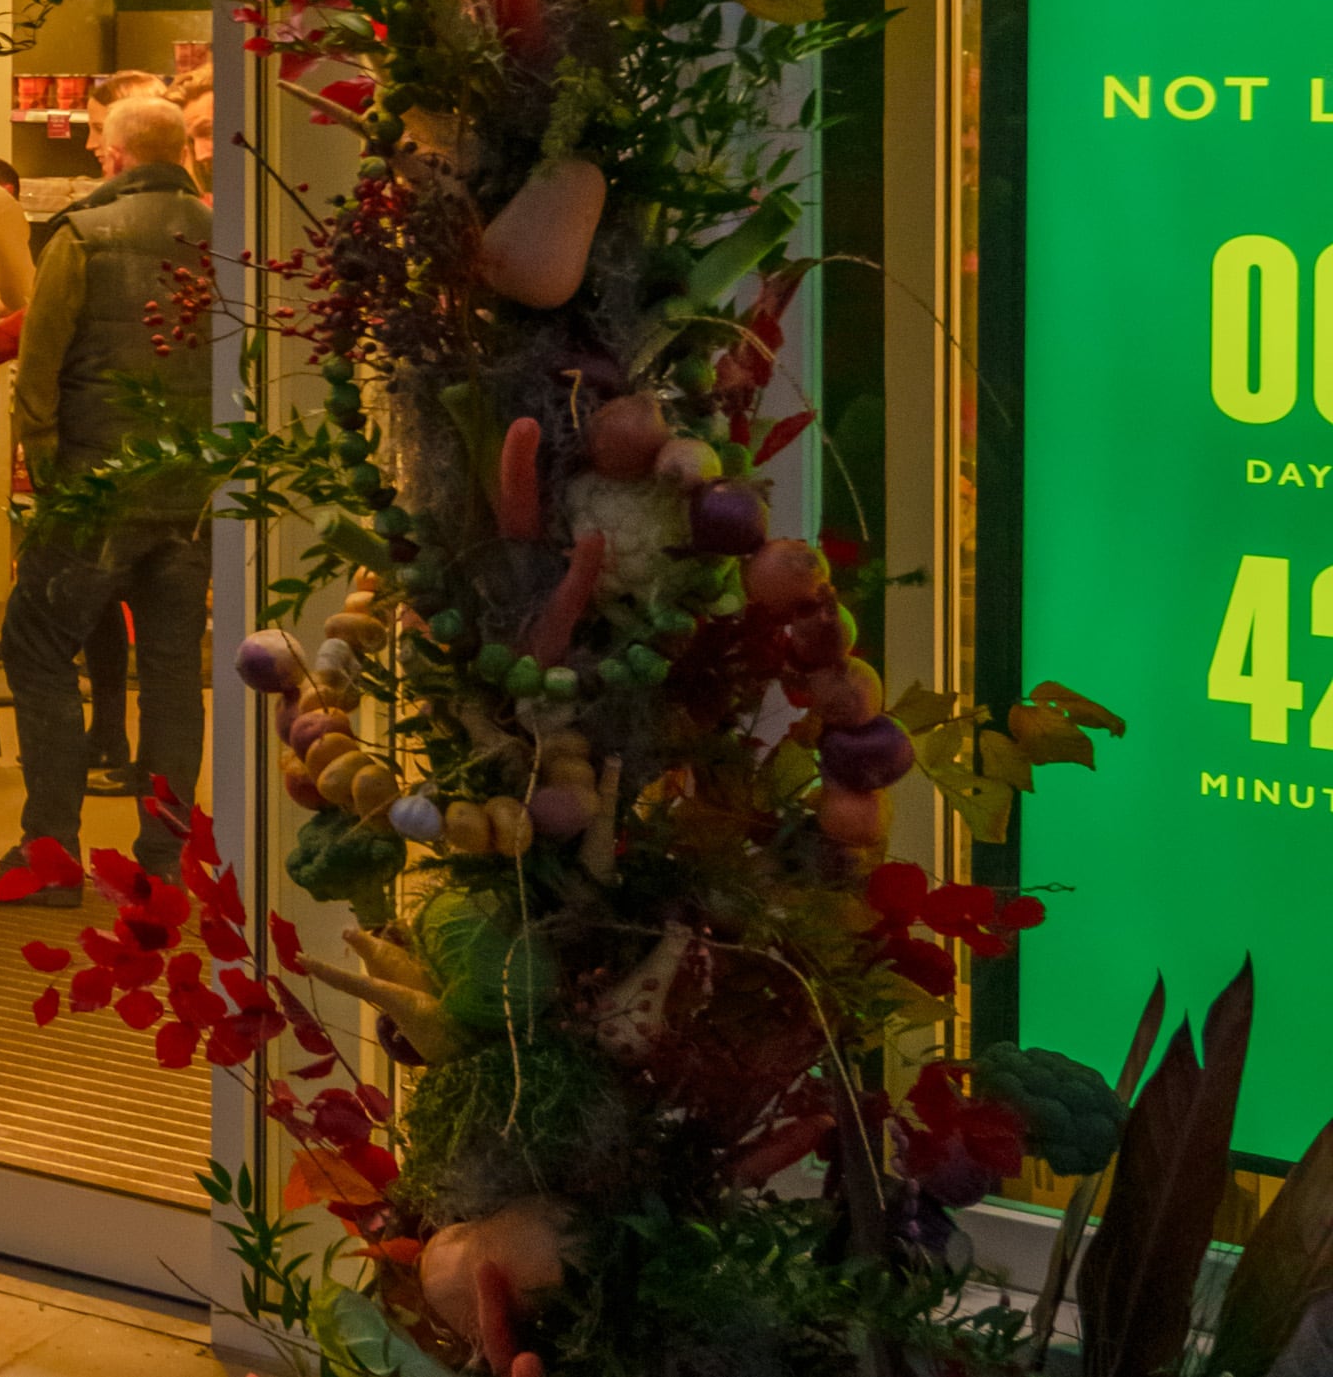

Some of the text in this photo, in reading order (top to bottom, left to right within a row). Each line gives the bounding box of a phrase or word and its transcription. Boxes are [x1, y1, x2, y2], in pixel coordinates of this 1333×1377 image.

[1103, 75, 1269, 121] NOT
[1211, 234, 1333, 424] 0
[1208, 554, 1333, 751] 4
